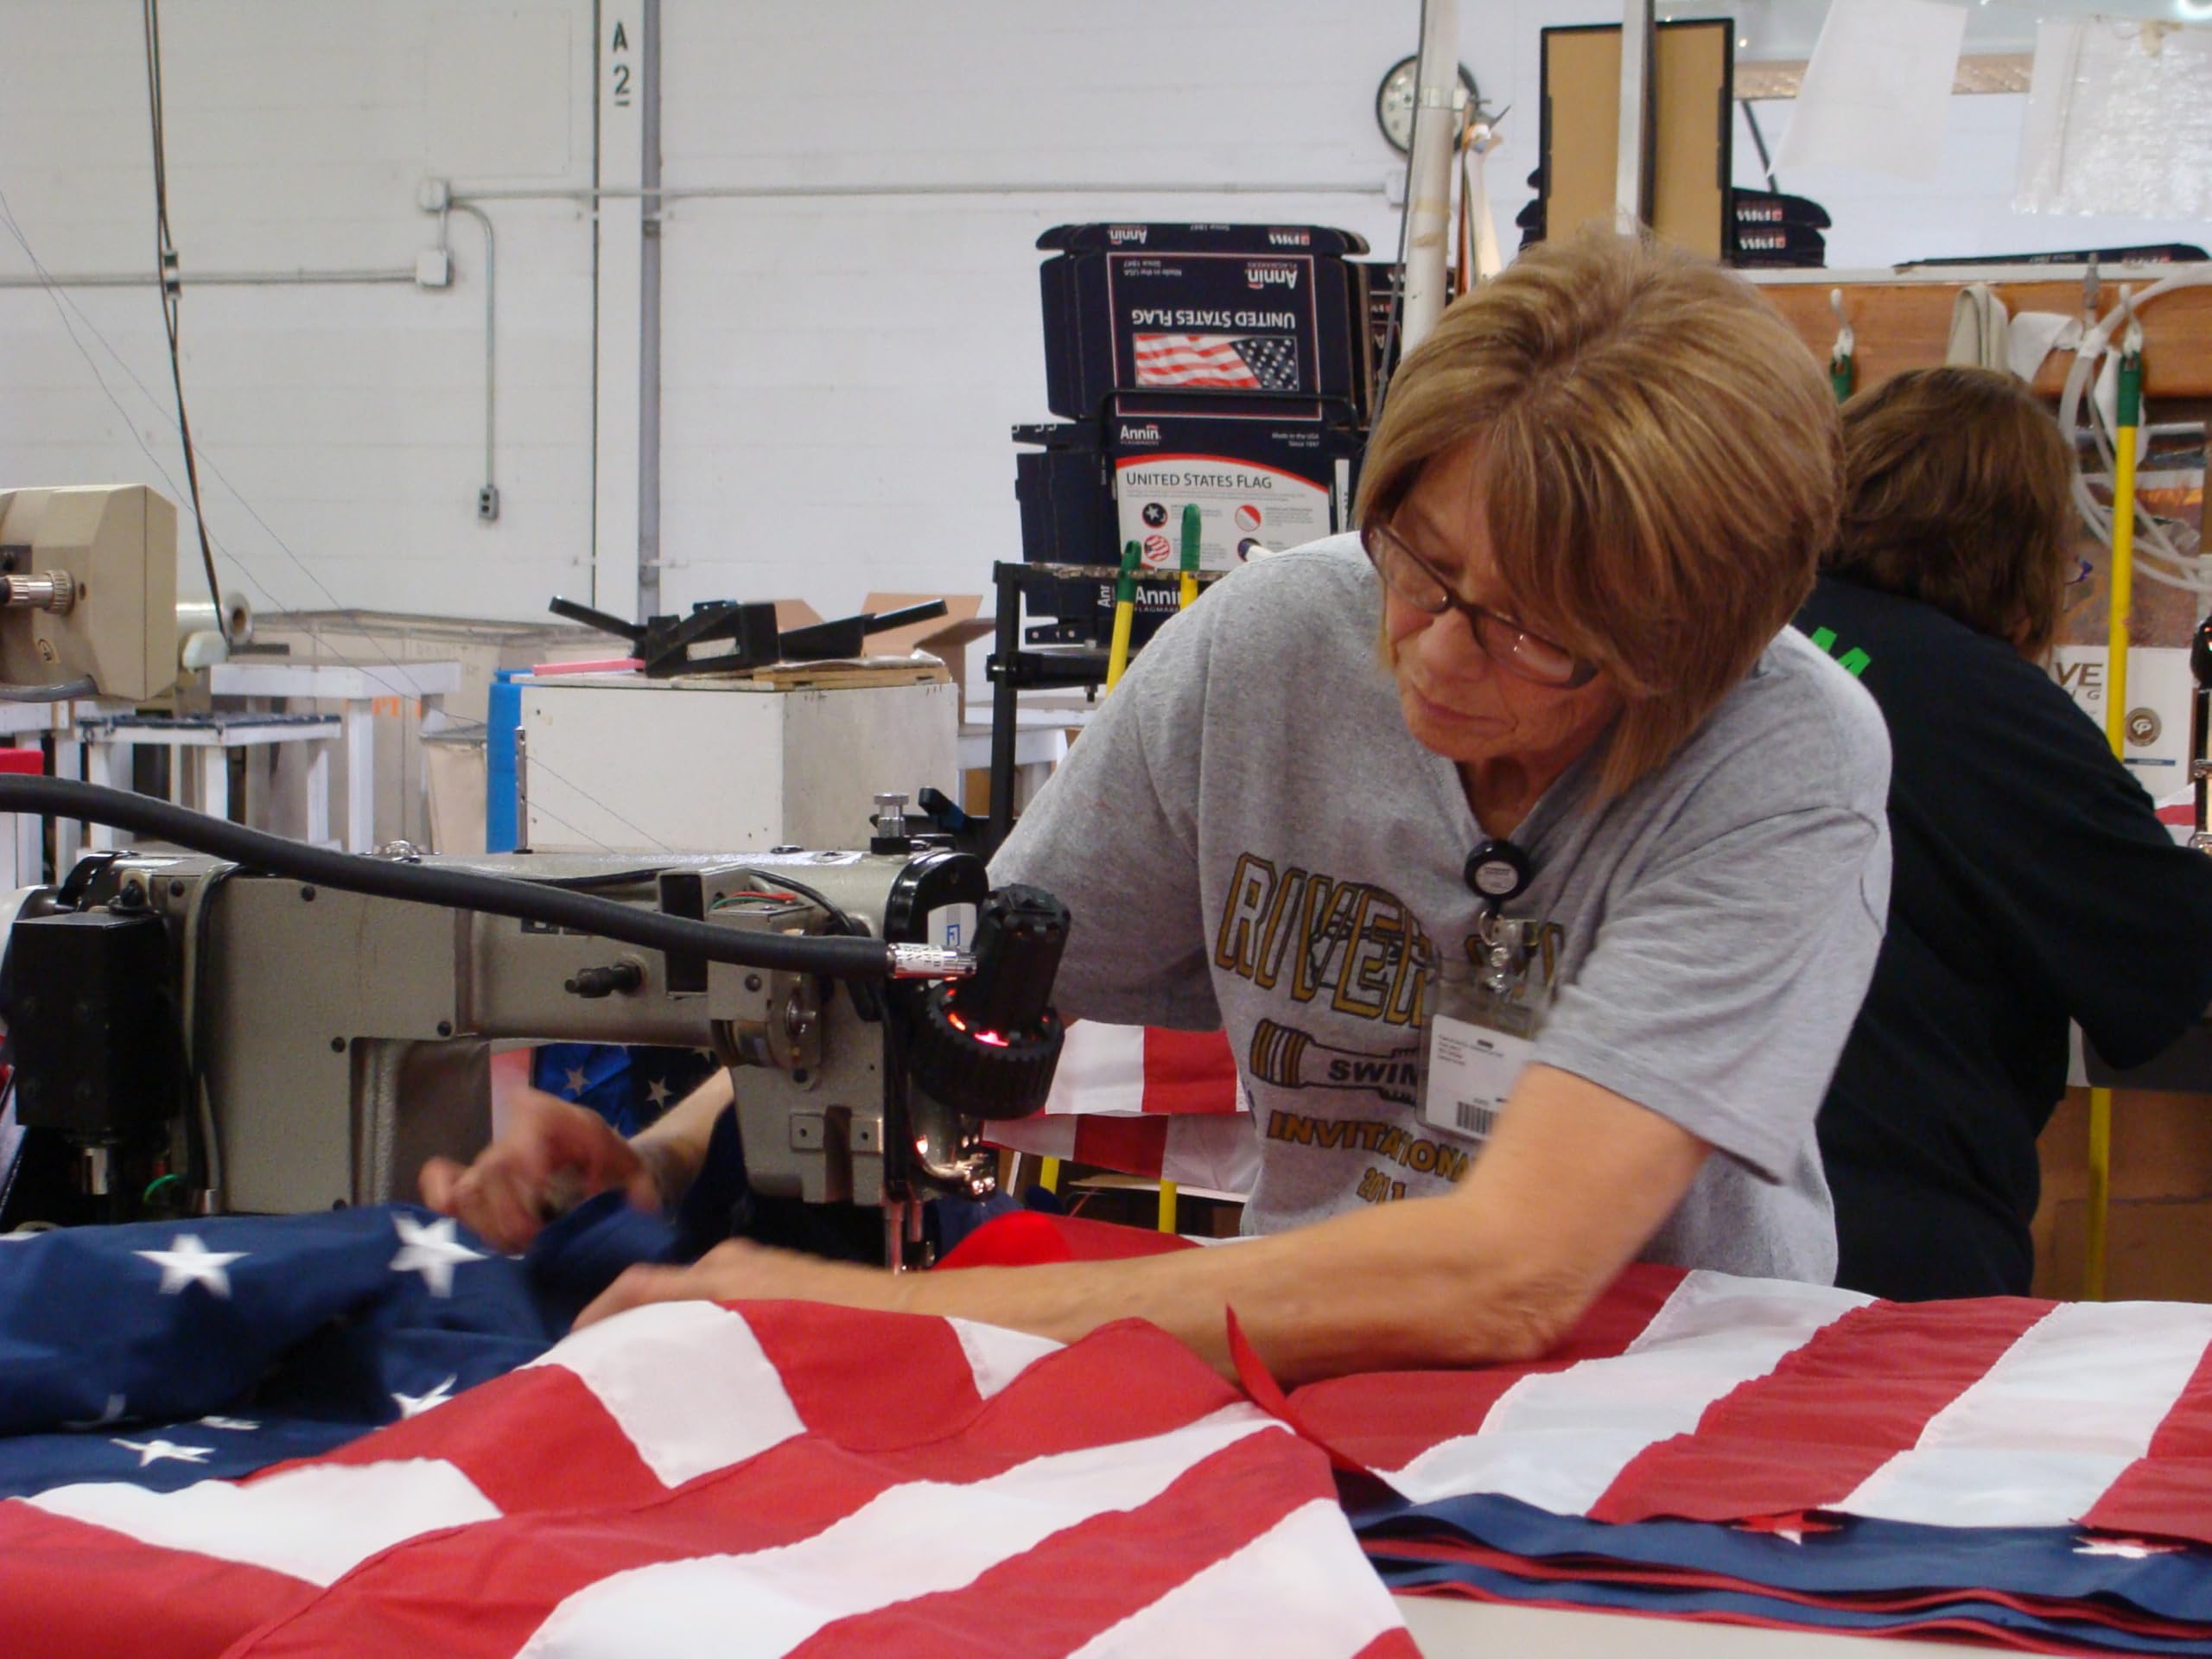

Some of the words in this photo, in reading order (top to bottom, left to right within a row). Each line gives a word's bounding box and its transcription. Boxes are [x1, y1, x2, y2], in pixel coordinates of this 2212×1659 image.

[1247, 269, 1298, 289] Annin
[1131, 308, 1173, 327] FLAG
[1176, 309, 1231, 327] STATES
[1234, 311, 1296, 329] UNITED
[1120, 423, 1160, 440] Annin
[1126, 472, 1180, 486] UNITED
[1183, 473, 1233, 488] STATES
[1236, 474, 1272, 490] FLAG
